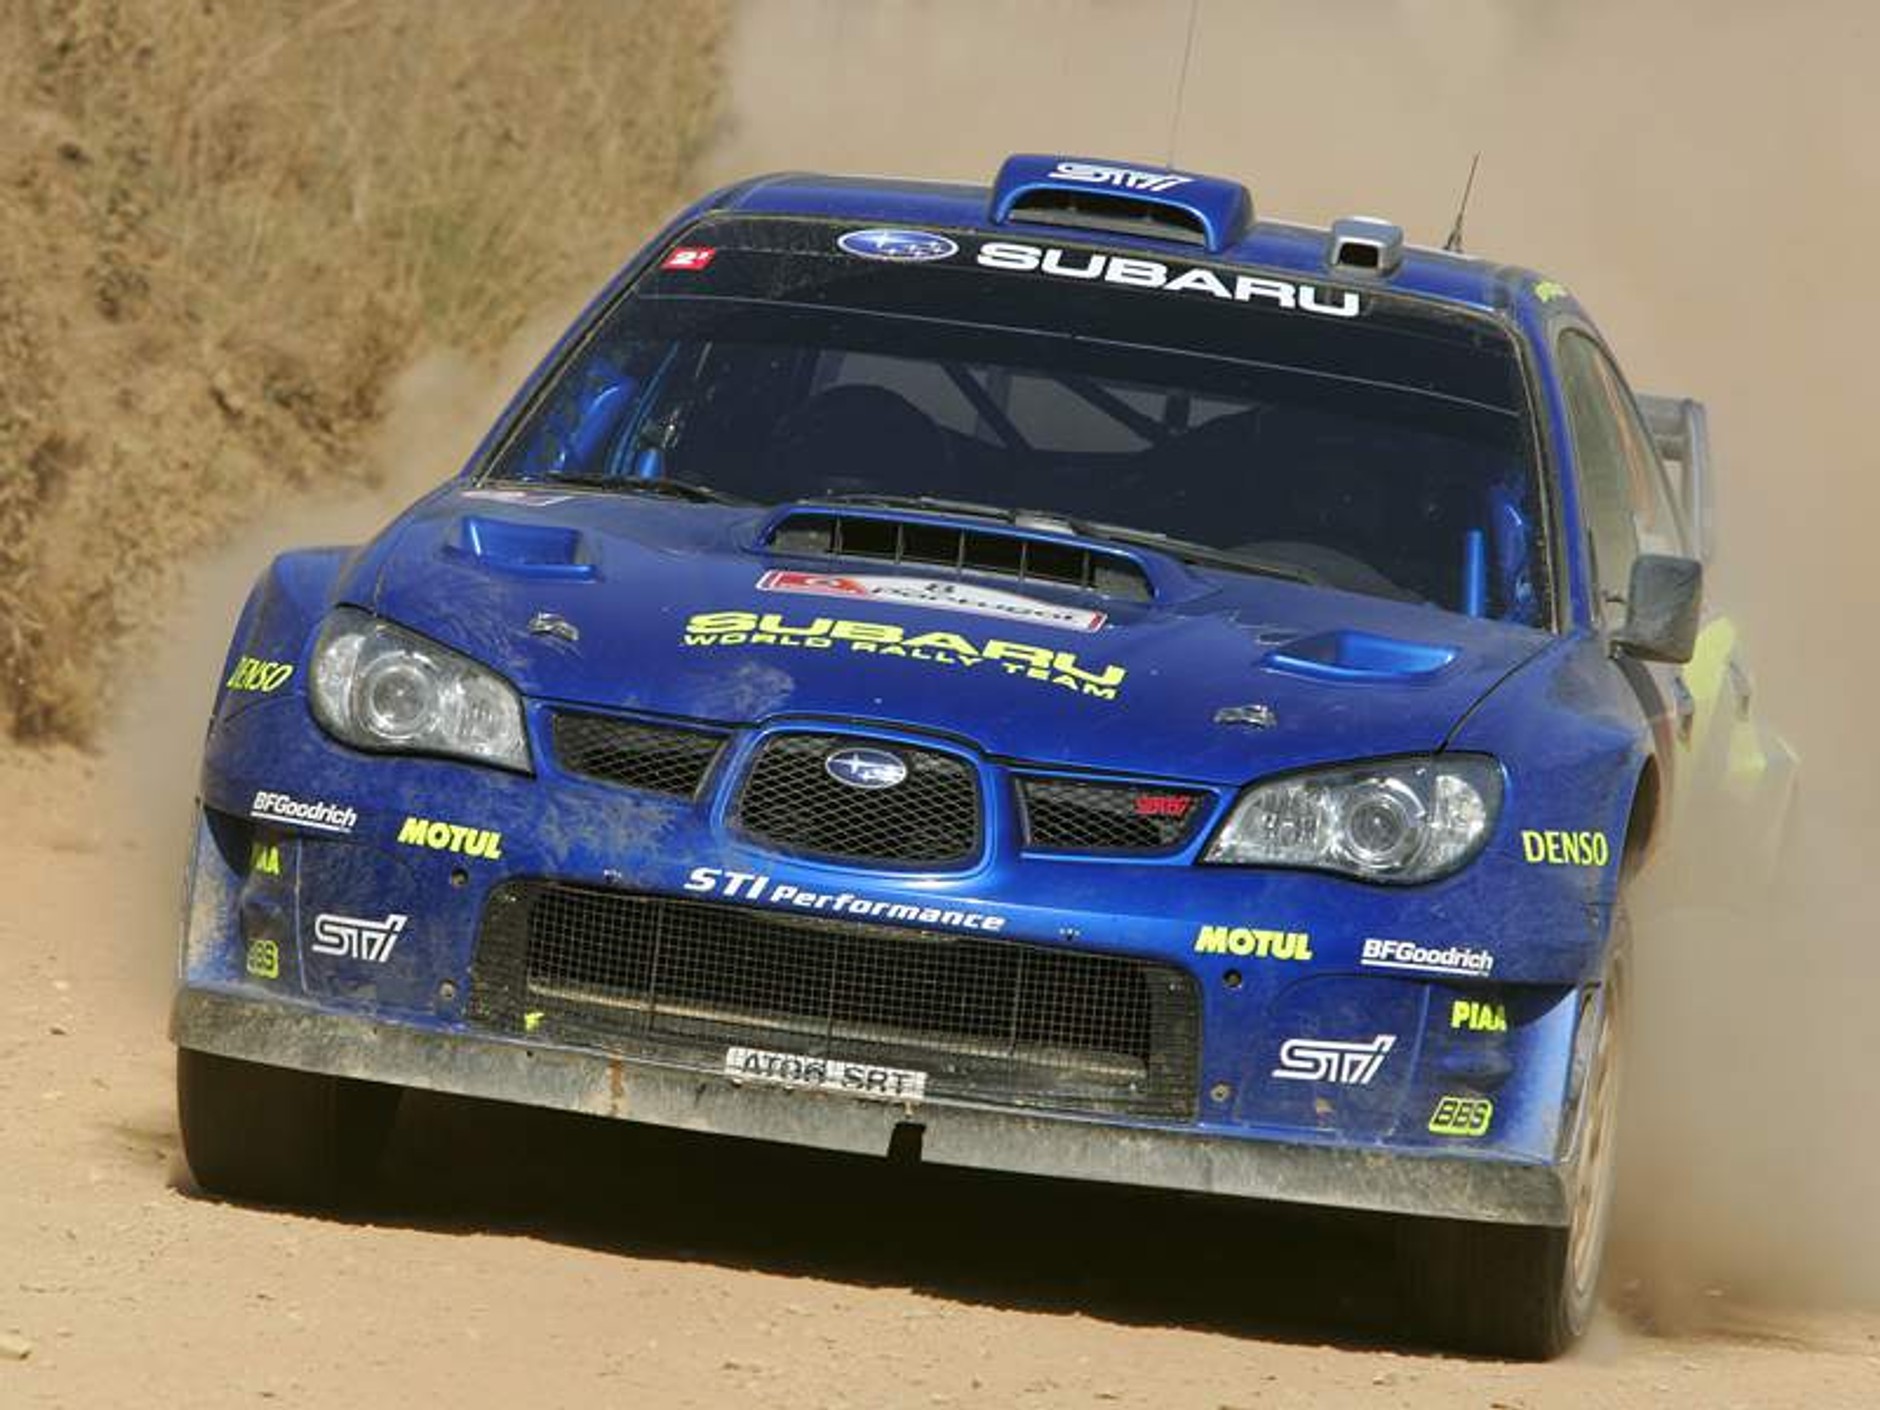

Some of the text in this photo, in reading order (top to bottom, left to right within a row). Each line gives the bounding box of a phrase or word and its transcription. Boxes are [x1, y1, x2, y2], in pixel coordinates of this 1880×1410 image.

[977, 241, 1360, 318] SUBARU
[683, 632, 1117, 699] WORLD RALLY TEAM
[685, 611, 1126, 687] SUBARU
[252, 791, 357, 828] BFGoodrich
[398, 817, 502, 860] MOTUL
[1521, 829, 1609, 866] DENSO
[684, 867, 1006, 932] STI Performance
[1195, 925, 1312, 960] MOTUL
[1361, 938, 1493, 971] BFGoodrich
[1451, 1000, 1507, 1031] PIAA
[841, 1065, 912, 1094] SRT
[1430, 1098, 1492, 1134] BBS
